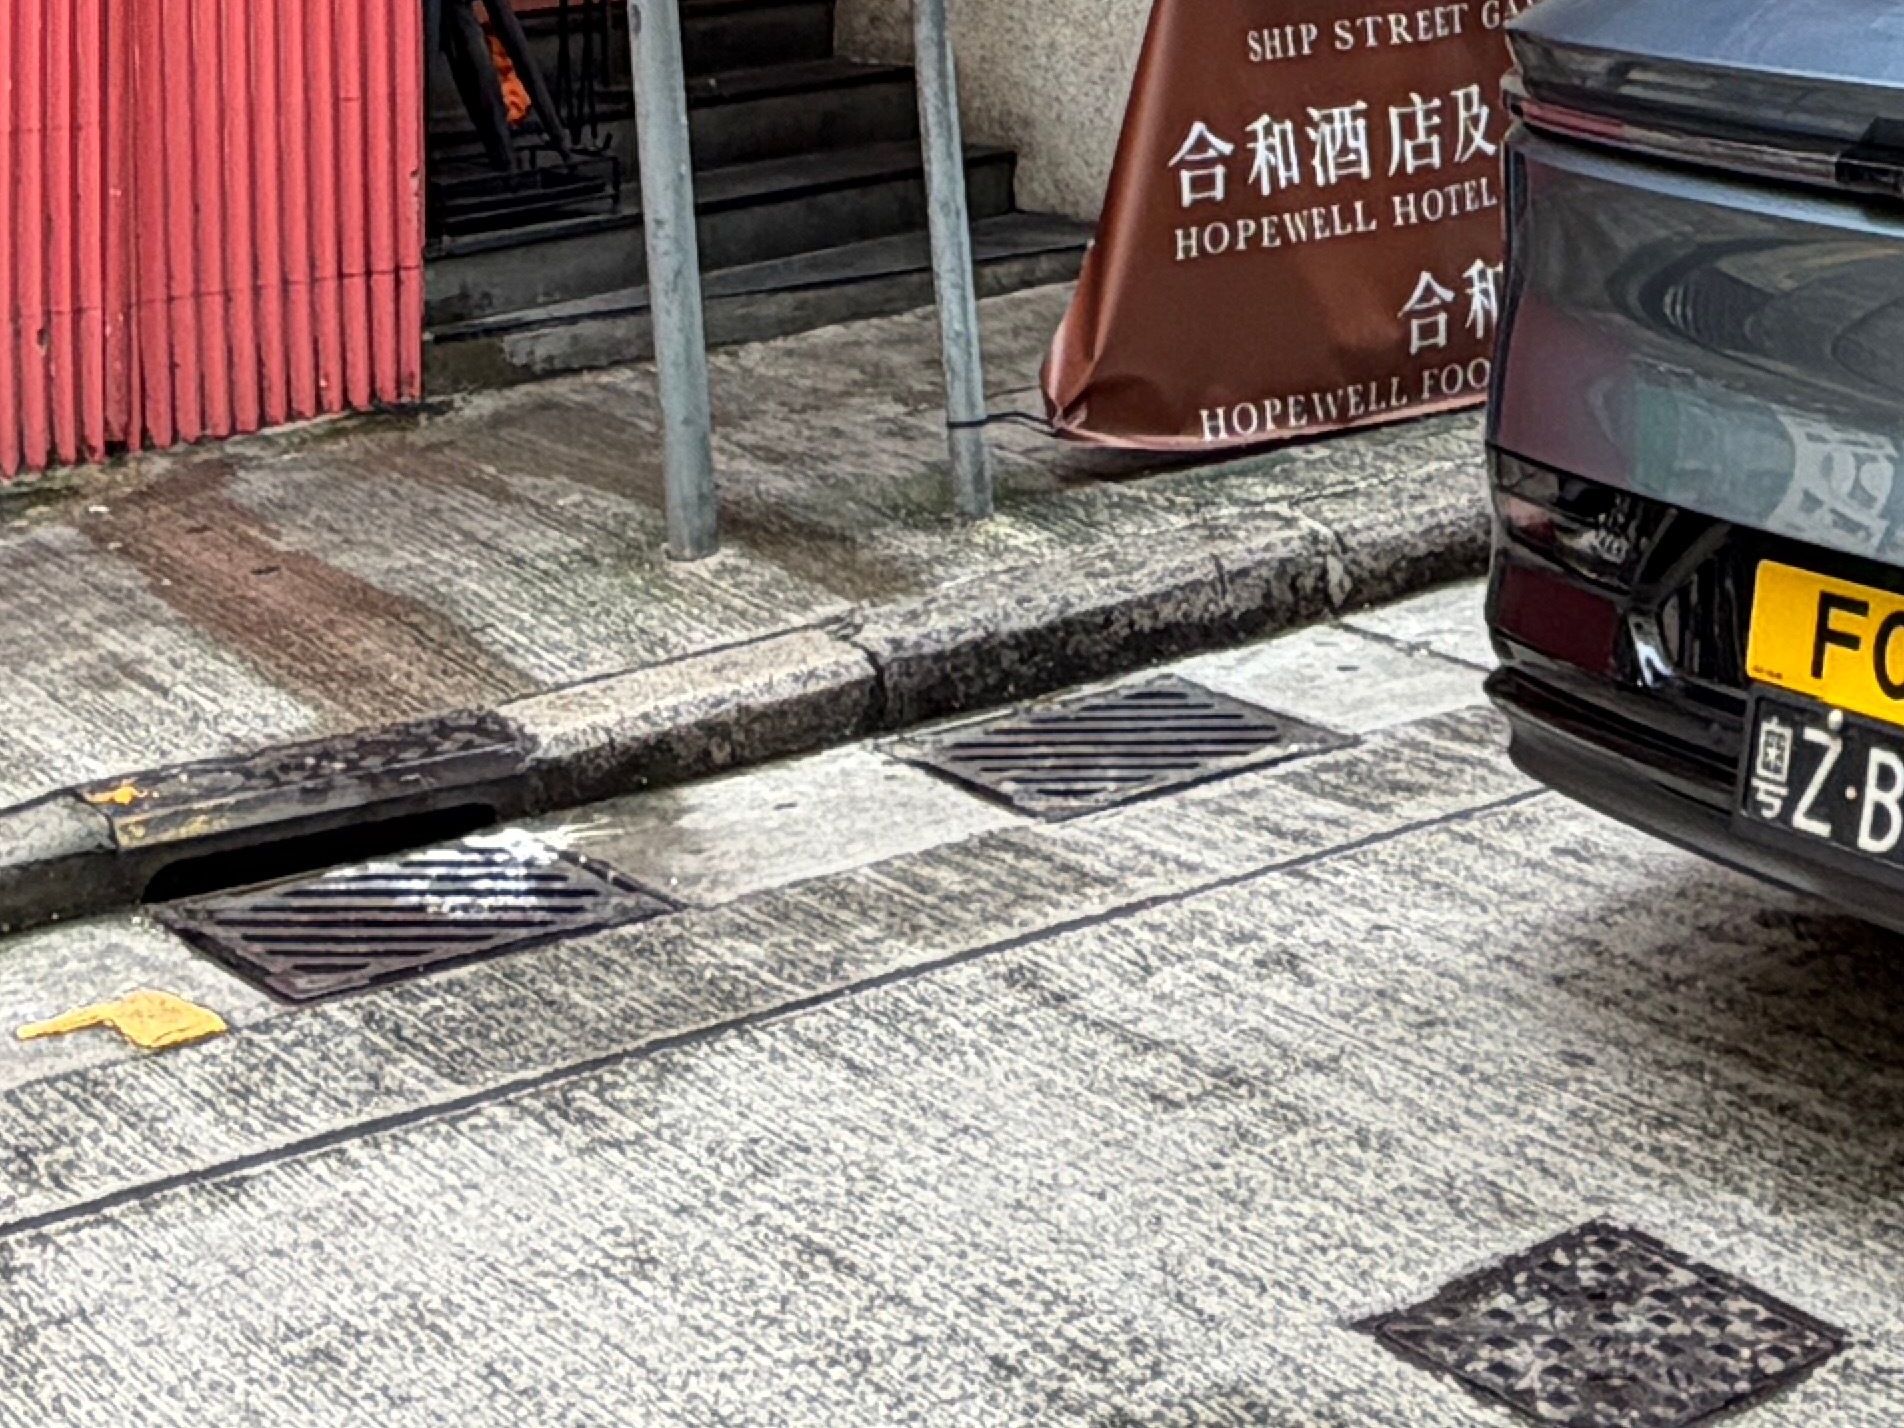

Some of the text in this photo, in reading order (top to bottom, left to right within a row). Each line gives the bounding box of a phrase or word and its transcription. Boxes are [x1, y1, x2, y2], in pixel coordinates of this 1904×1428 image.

[1247, 21, 1319, 63] SHIP
[1333, 2, 1468, 51] STREET
[1168, 83, 1497, 207] 合和酒店及
[1174, 176, 1498, 261] HOPEWELL HOTEL
[1200, 356, 1492, 442] HOPEWELL FOO
